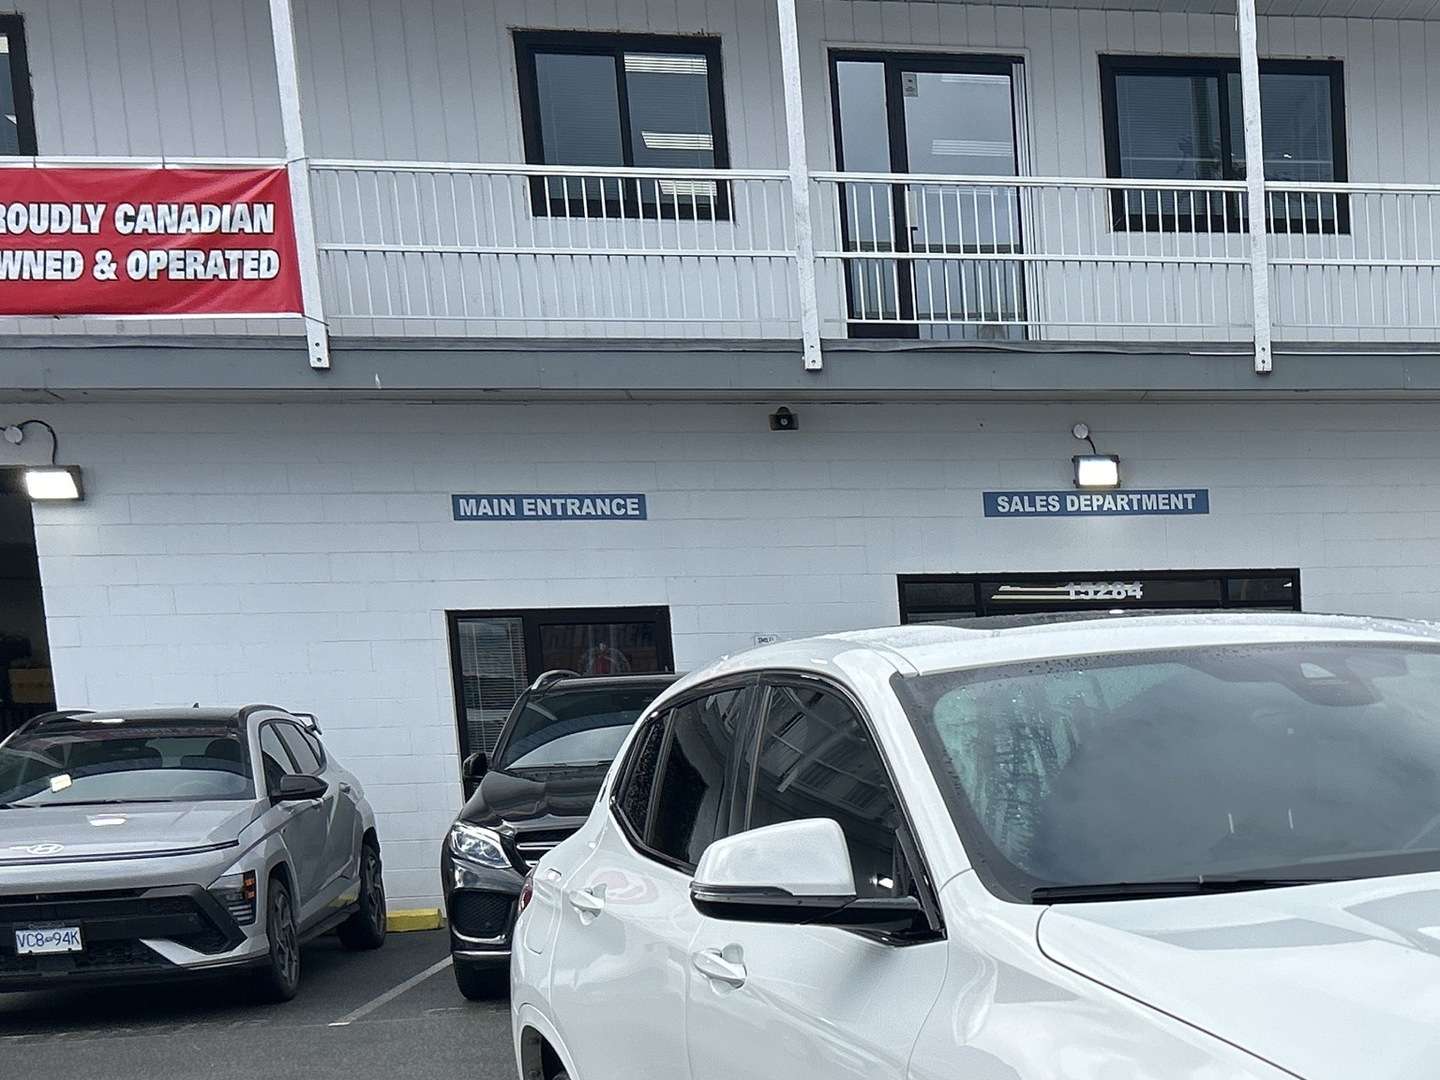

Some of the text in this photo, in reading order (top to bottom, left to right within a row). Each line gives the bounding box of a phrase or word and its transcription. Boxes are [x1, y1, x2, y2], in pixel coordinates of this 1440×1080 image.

[114, 203, 275, 234] CANADIAN
[92, 250, 118, 281] &
[126, 250, 280, 281] OPERATED
[459, 498, 640, 516] MAIN ENTRANCE
[997, 493, 1196, 513] SALES DEPARTMENT
